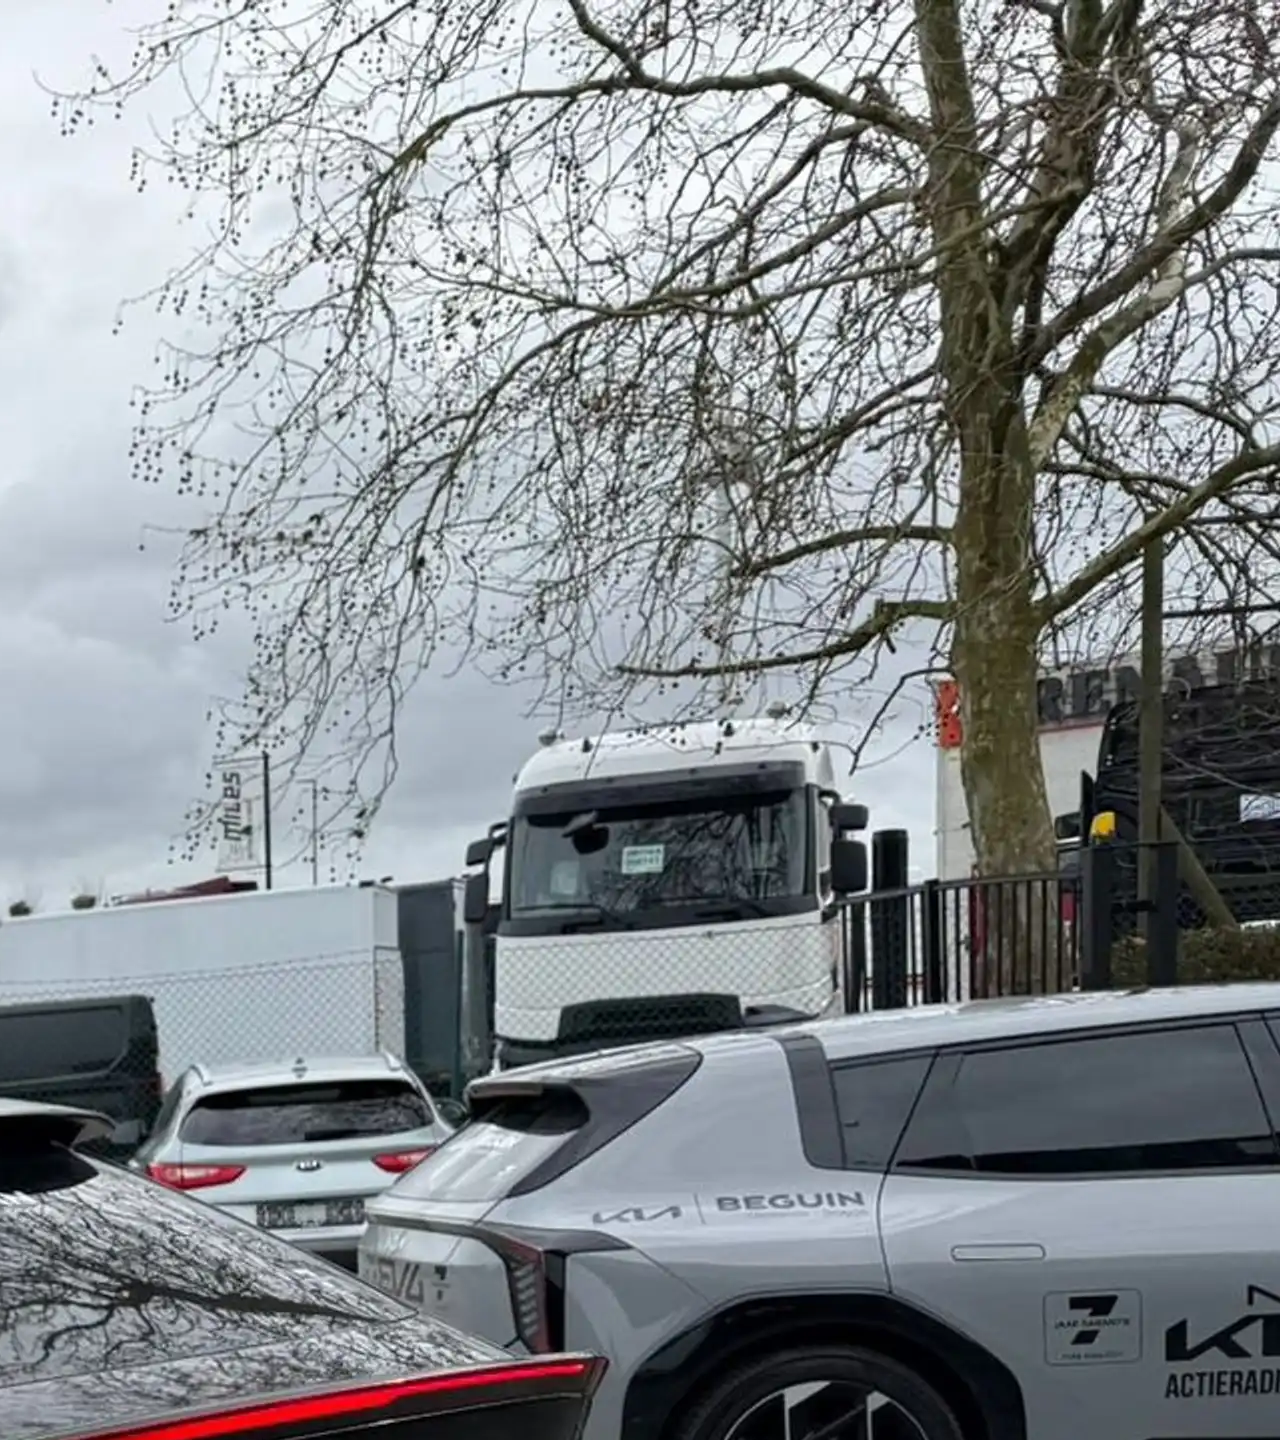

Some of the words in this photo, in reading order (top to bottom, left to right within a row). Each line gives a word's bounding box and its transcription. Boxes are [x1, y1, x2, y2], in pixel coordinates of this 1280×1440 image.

[592, 1205, 681, 1224] KIA
[715, 1191, 865, 1212] BEGUIN
[1068, 1294, 1119, 1346] 7
[1164, 1369, 1280, 1399] ACTIERADI
